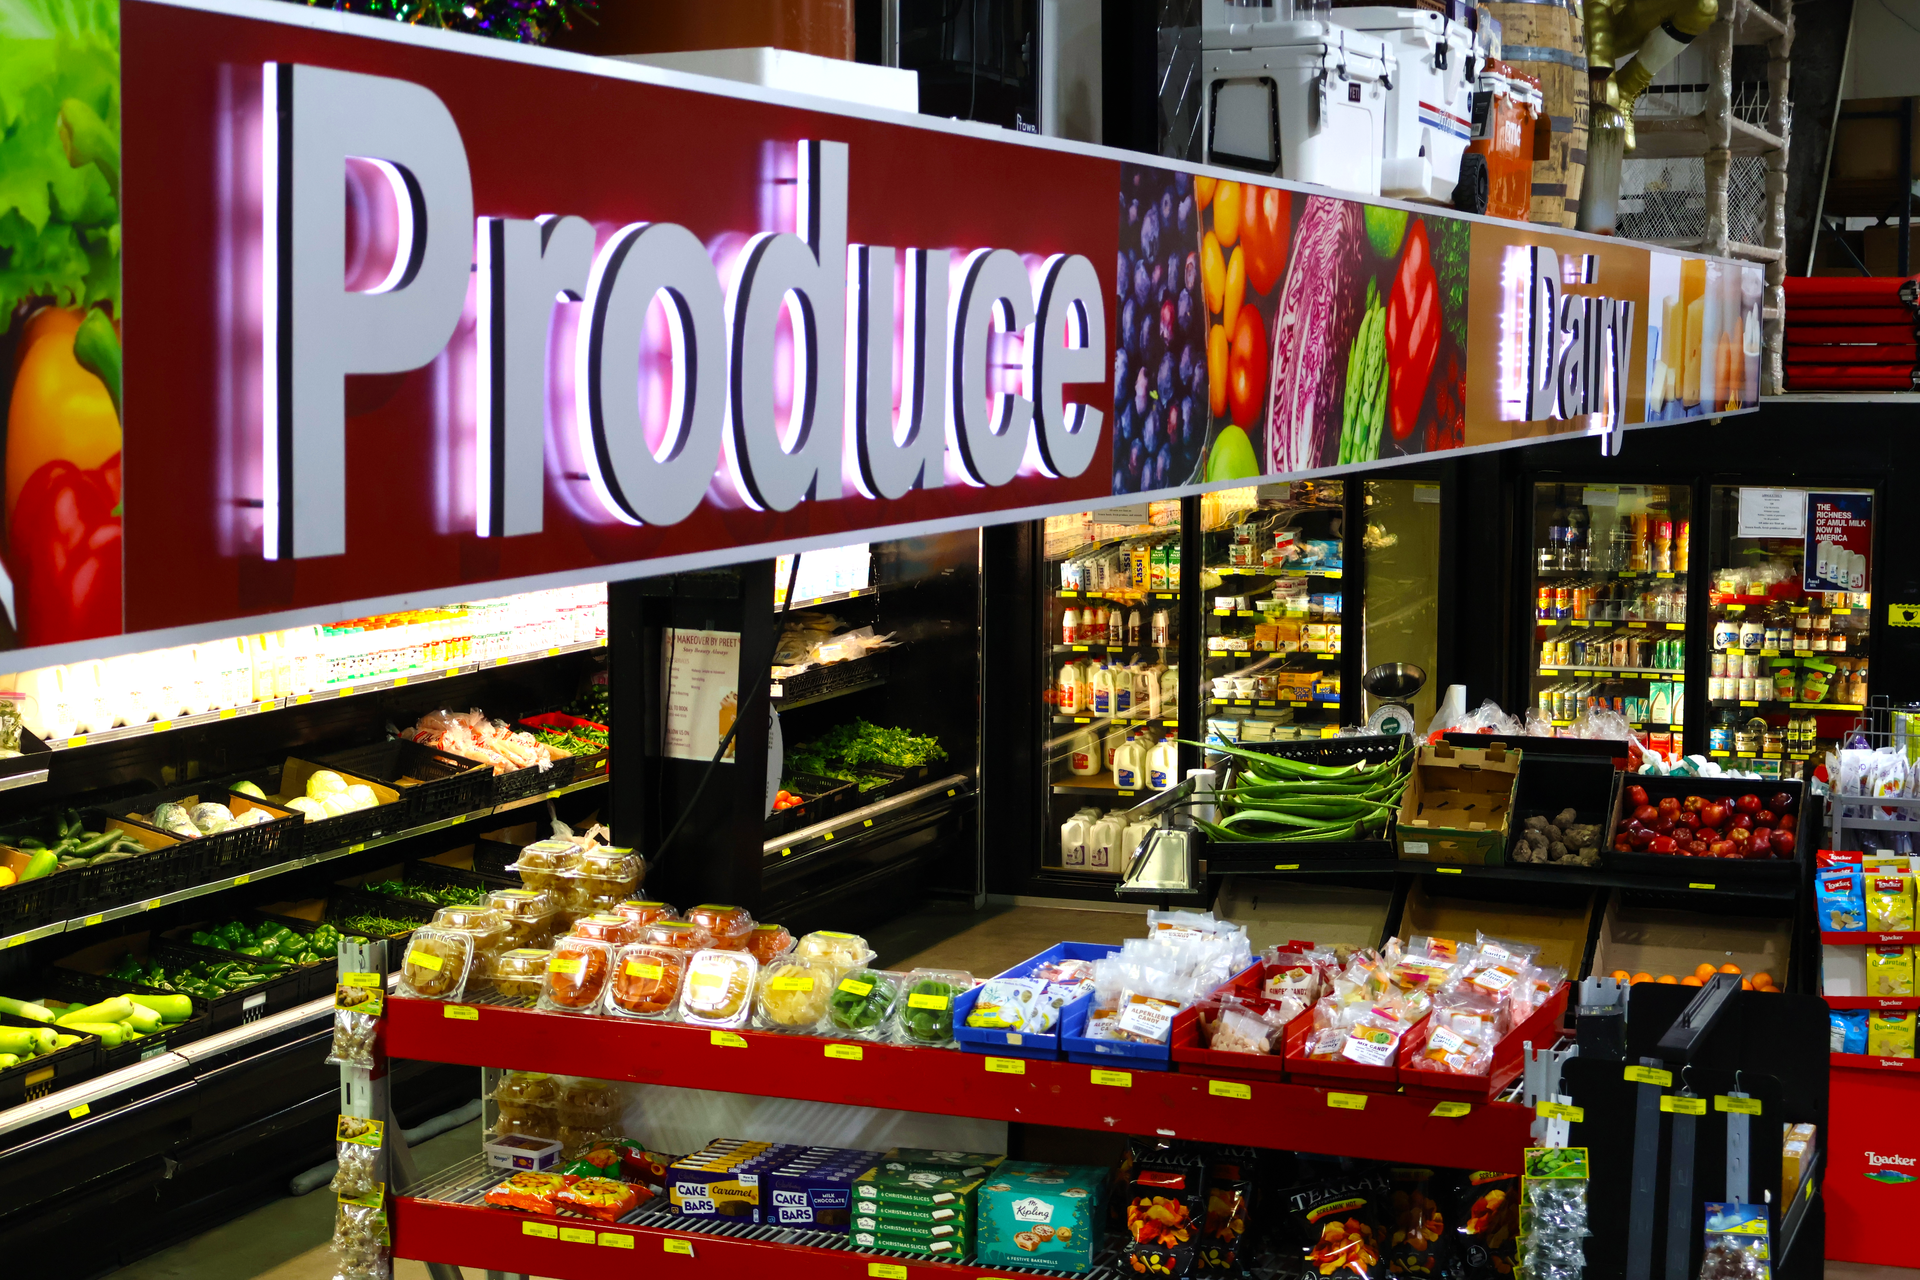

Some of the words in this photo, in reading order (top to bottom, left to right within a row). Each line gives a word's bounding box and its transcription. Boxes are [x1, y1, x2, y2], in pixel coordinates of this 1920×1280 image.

[262, 60, 1106, 560] Produce
[1520, 244, 1636, 457] Dairy
[1816, 503, 1831, 511] THE
[1816, 511, 1852, 519] RICHNESS
[1826, 519, 1847, 527] AMUL
[1815, 534, 1848, 542] AMERICA
[677, 634, 710, 646] MAKEOVER
[711, 638, 718, 646] BY
[719, 638, 738, 648] PREET
[1131, 1007, 1170, 1022] ALPENLIEBE
[1137, 1014, 1160, 1024] CANDY
[1369, 1044, 1389, 1053] CANDY
[1879, 1059, 1904, 1067] Loacker
[1864, 1151, 1917, 1167] Loacker
[678, 1185, 706, 1196] CAKE
[712, 1185, 752, 1197] Caramel
[775, 1193, 804, 1205] CAKE
[684, 1200, 713, 1211] BARS
[1316, 1203, 1345, 1216] SCREAMIN'
[1346, 1200, 1357, 1208] HOT
[781, 1209, 812, 1220] BARS
[884, 1208, 912, 1216] CHRISTMAS
[1016, 1206, 1049, 1220] Kipling
[882, 1240, 910, 1248] CHRISTMAS
